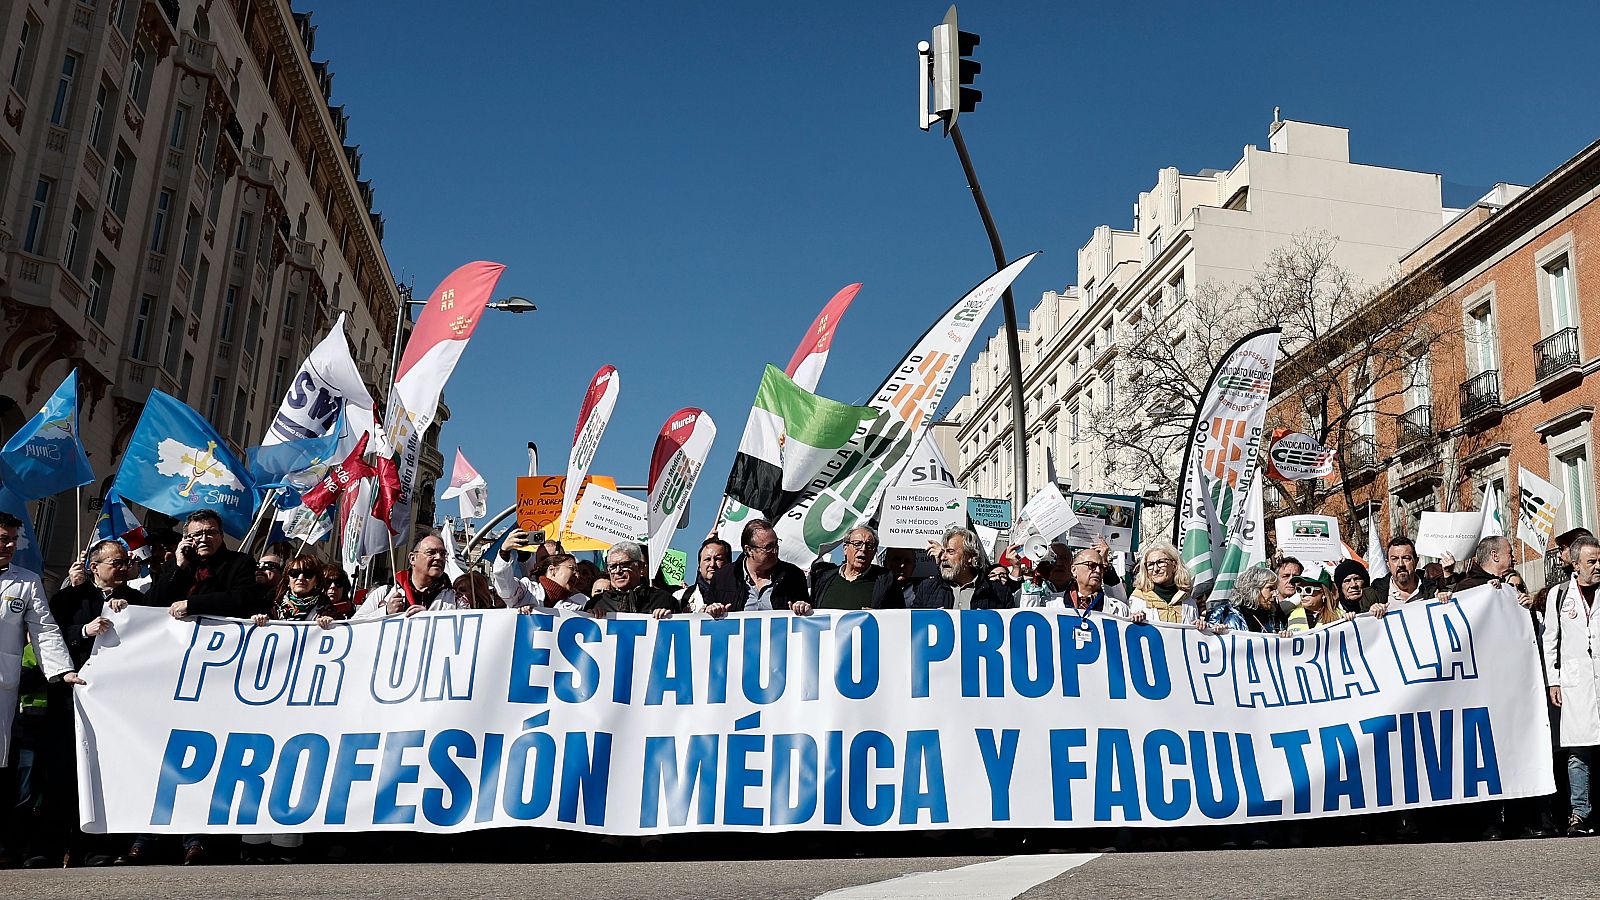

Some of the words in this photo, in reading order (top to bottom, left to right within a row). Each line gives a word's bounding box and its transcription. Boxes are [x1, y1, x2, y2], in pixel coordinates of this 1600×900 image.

[1248, 368, 1272, 381] MÉDICO
[920, 353, 960, 428] Mancha
[671, 414, 696, 432] Murcia
[407, 414, 430, 453] Murcia
[1278, 440, 1311, 451] SINDICATO
[405, 453, 414, 468] de
[1238, 426, 1262, 492] Mancha
[652, 477, 671, 514] Sindicato
[668, 449, 683, 478] Médico
[677, 490, 689, 511] Región
[689, 462, 702, 483] Murcia
[536, 497, 564, 506] PODREM
[600, 494, 611, 502] SIN
[908, 494, 939, 502] MÉDICOS
[592, 500, 602, 508] NO
[602, 503, 615, 512] HAY
[614, 508, 642, 521] SANIDAD
[593, 513, 605, 522] SIN
[908, 517, 939, 526] MÉDICOS
[982, 518, 1009, 528] Centro
[584, 520, 595, 528] NO
[595, 523, 608, 532] HAY
[607, 528, 635, 541] SANIDAD
[914, 528, 944, 536] SANIDAD
[173, 616, 353, 706] POR
[369, 613, 483, 703] UN
[507, 611, 880, 706] ESTATUTO
[910, 609, 1172, 700] PROPIO
[1182, 619, 1380, 709] PARA
[1382, 598, 1478, 685] LA
[149, 709, 613, 828] PROFESIÓN
[639, 711, 949, 829] MÉDICA
[974, 728, 1021, 822] Y
[1048, 706, 1503, 822] FACULTATIVA
